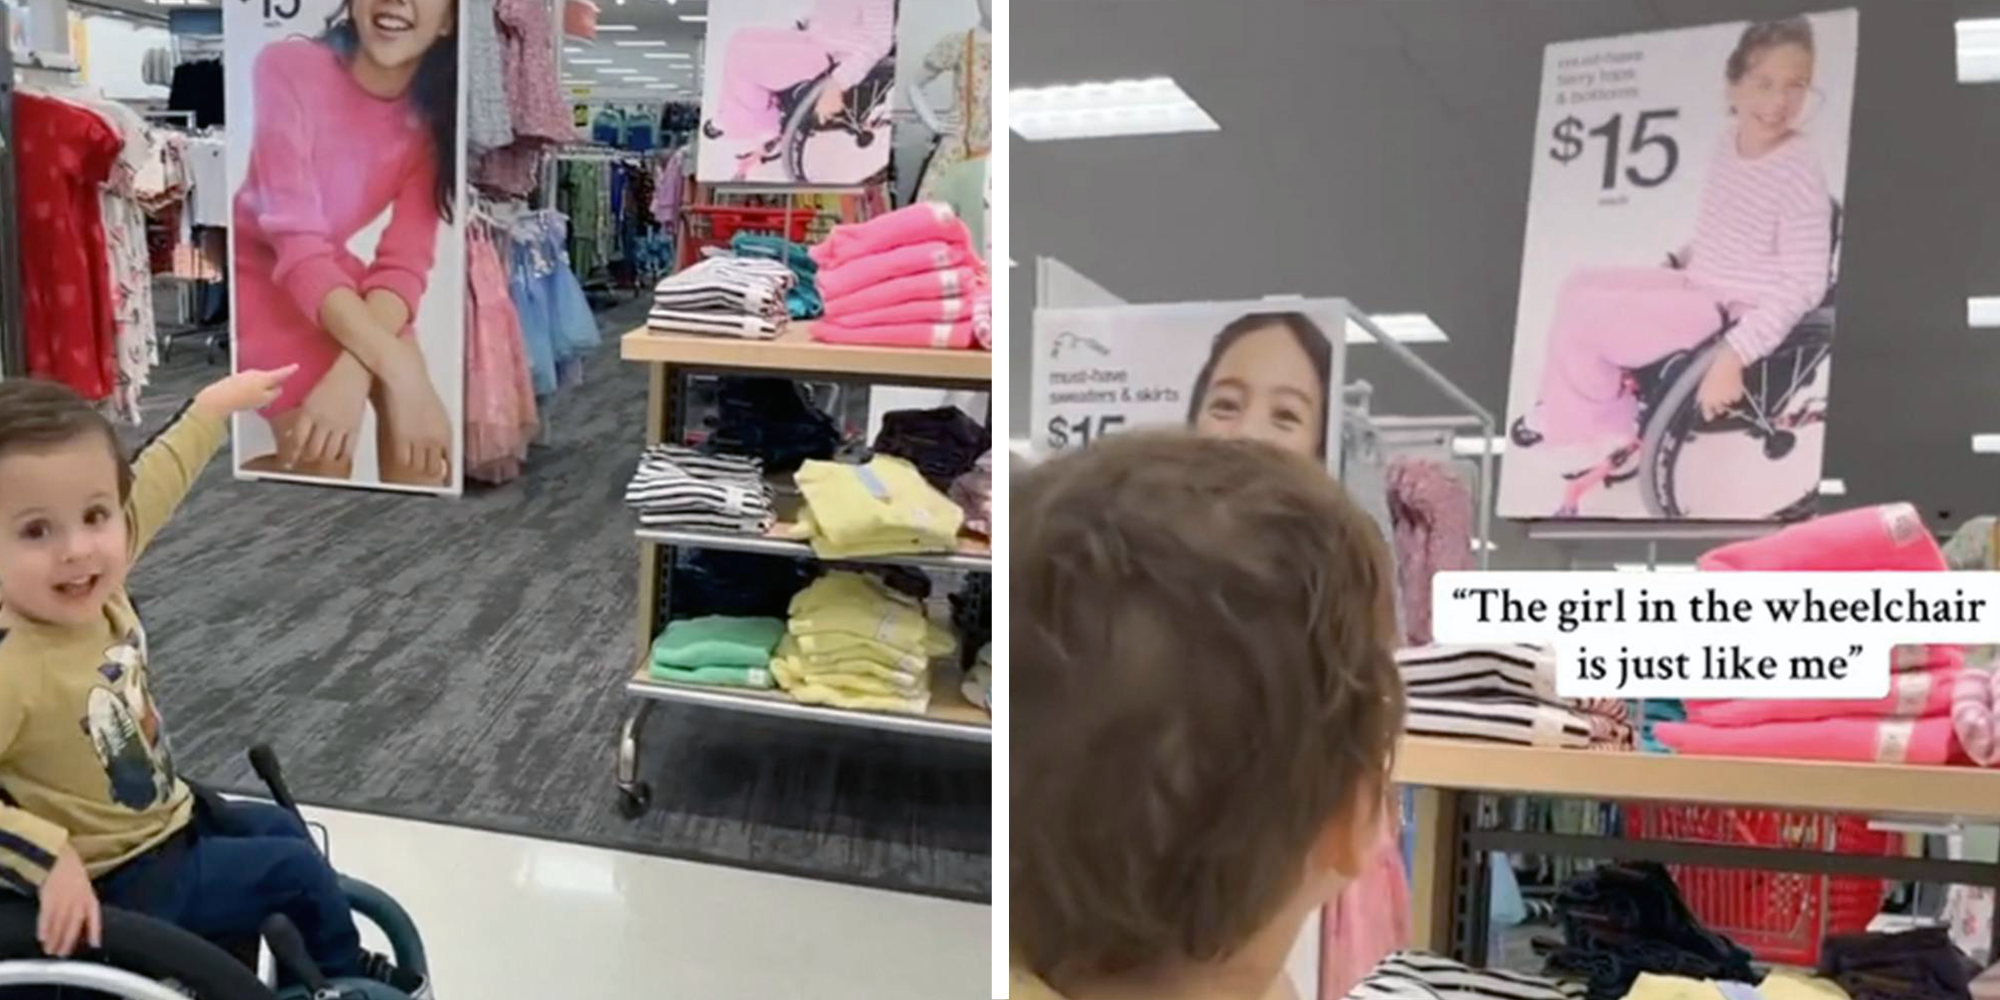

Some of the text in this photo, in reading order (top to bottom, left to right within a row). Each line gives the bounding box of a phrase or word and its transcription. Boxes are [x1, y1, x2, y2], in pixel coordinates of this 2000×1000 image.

[1549, 107, 1680, 189] $15
[1050, 369, 1127, 383] must-have
[1050, 387, 1179, 404] sweaters & skirts
